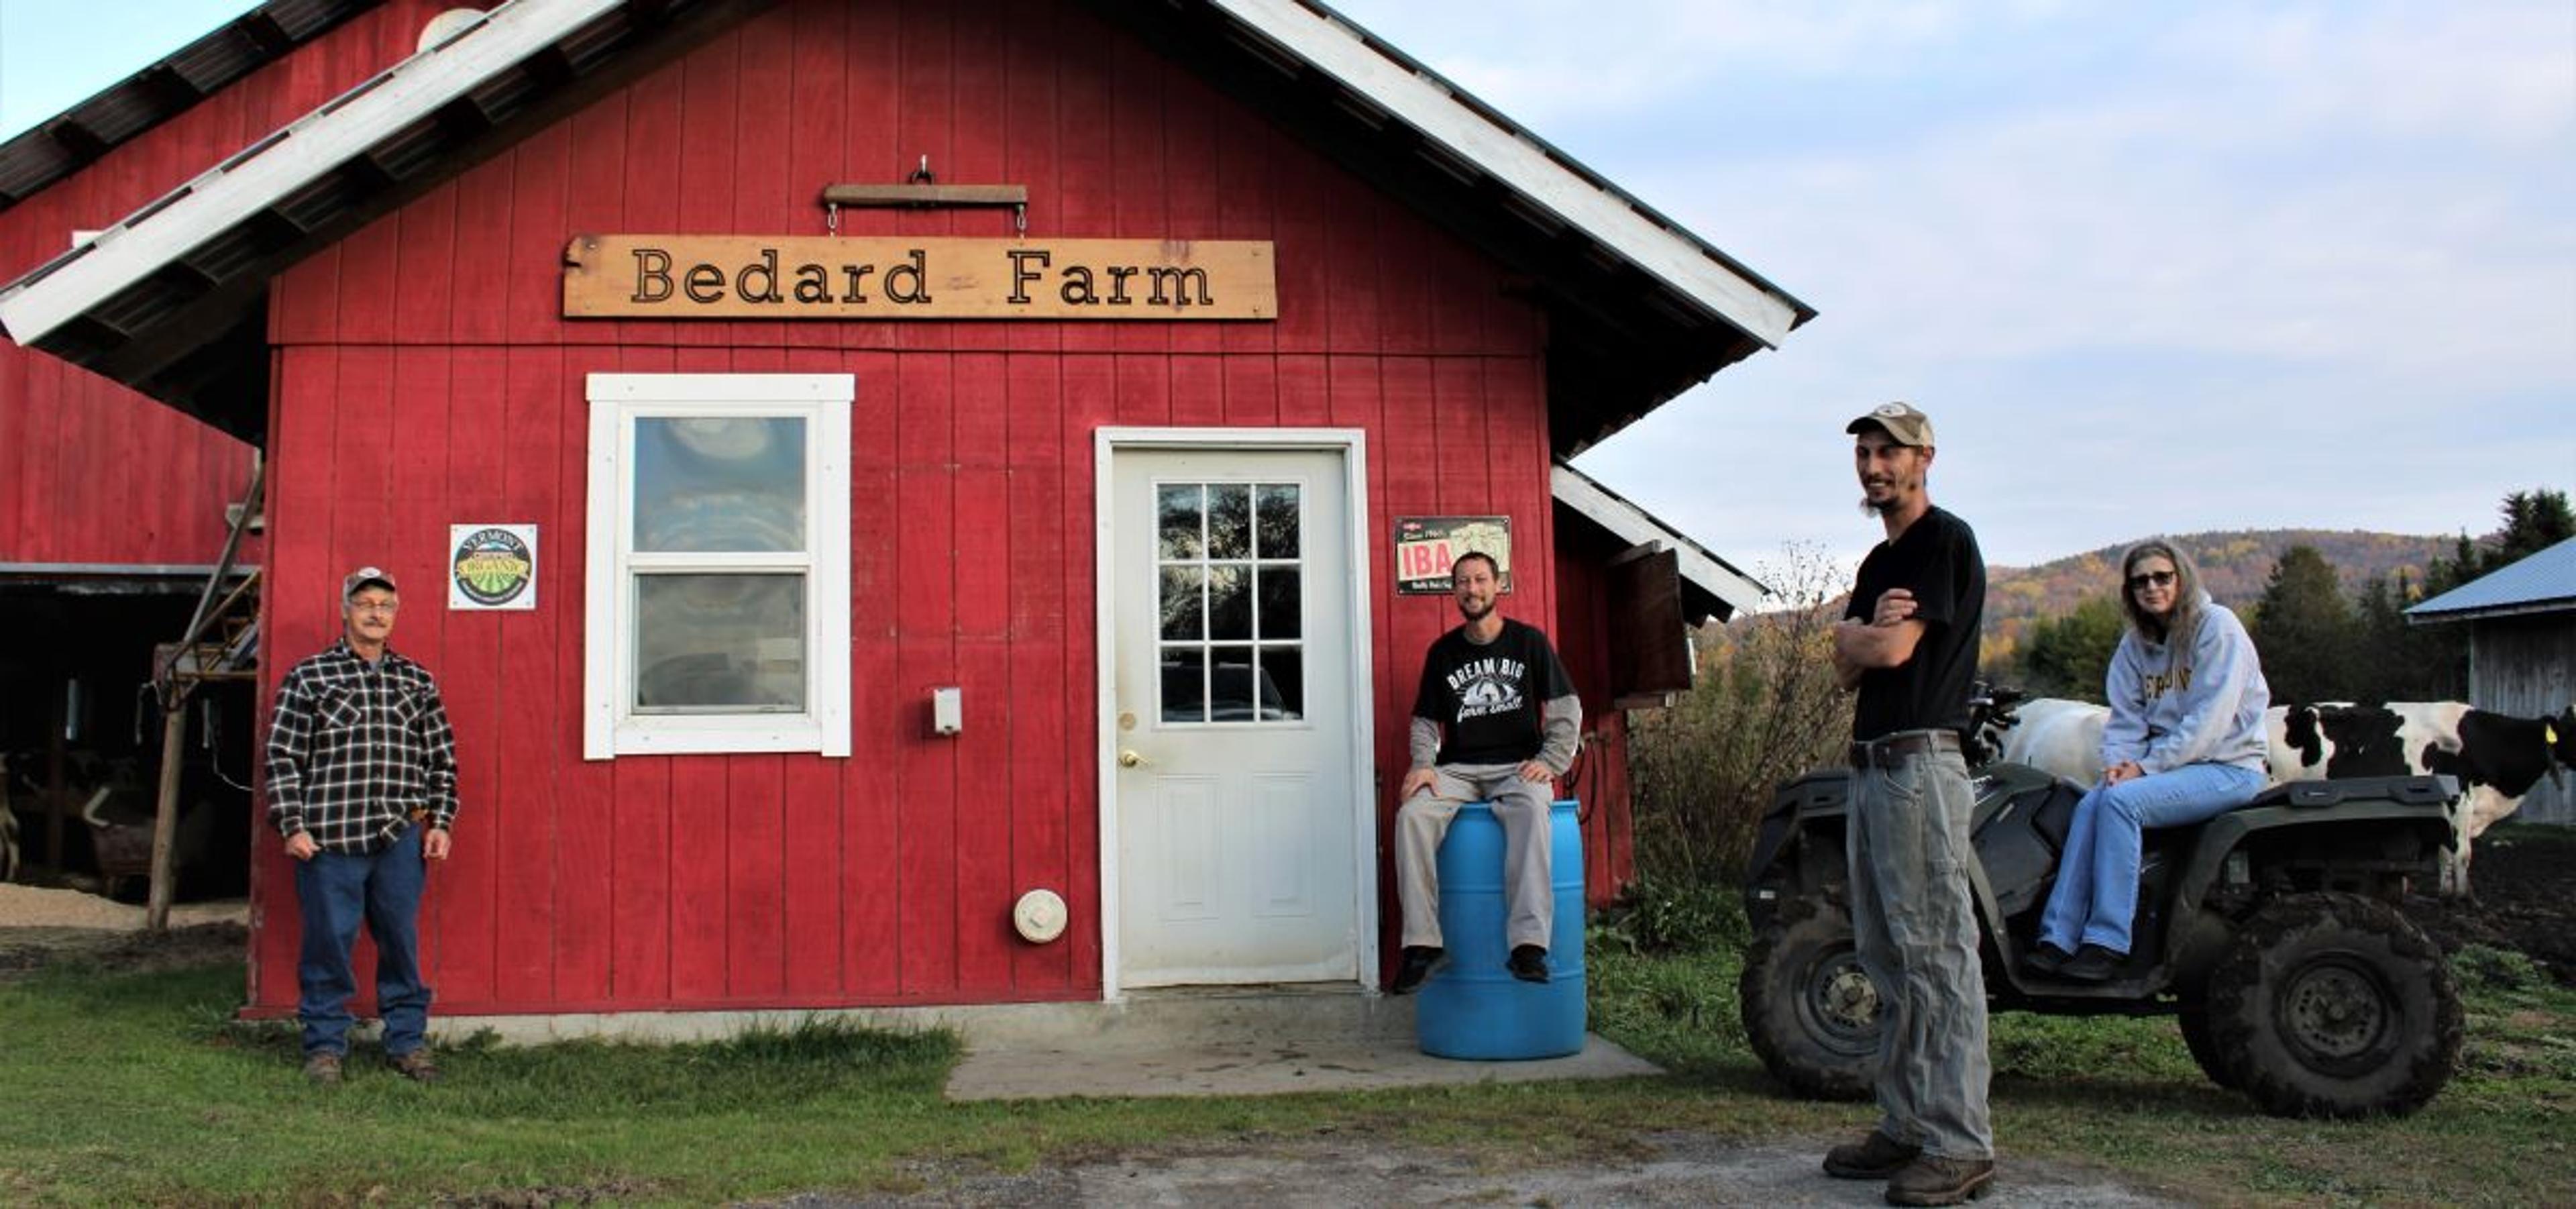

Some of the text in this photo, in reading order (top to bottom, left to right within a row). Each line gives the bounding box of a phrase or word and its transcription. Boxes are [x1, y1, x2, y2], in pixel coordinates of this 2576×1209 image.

[631, 248, 1214, 305] Bedard Farm
[464, 529, 525, 551] VERMONT
[1403, 543, 1452, 576] IBA
[1446, 658, 1525, 690] DREAM BIG
